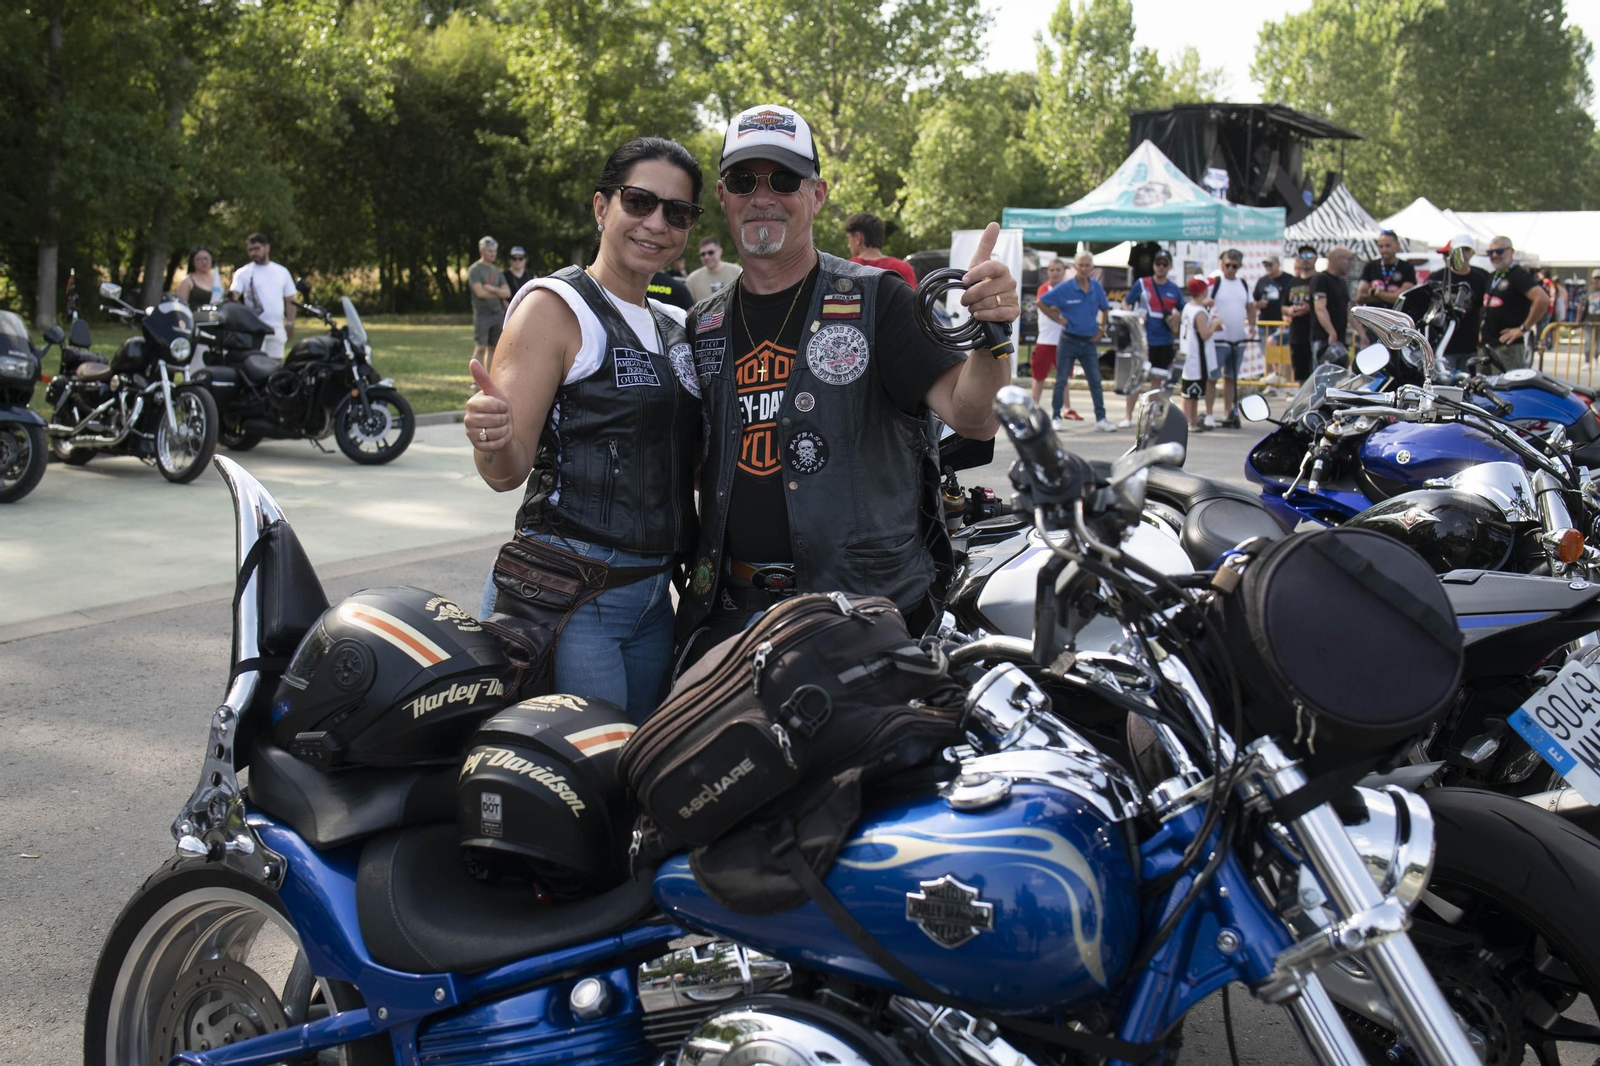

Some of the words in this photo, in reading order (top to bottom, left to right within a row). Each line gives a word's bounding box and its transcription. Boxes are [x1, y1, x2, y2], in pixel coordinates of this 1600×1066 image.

[827, 326, 845, 336] DOS
[620, 375, 656, 384] OURENSE
[817, 364, 861, 382] OURENSE
[1535, 672, 1600, 740] 9049
[1548, 746, 1563, 762] E
[483, 801, 500, 813] DOT
